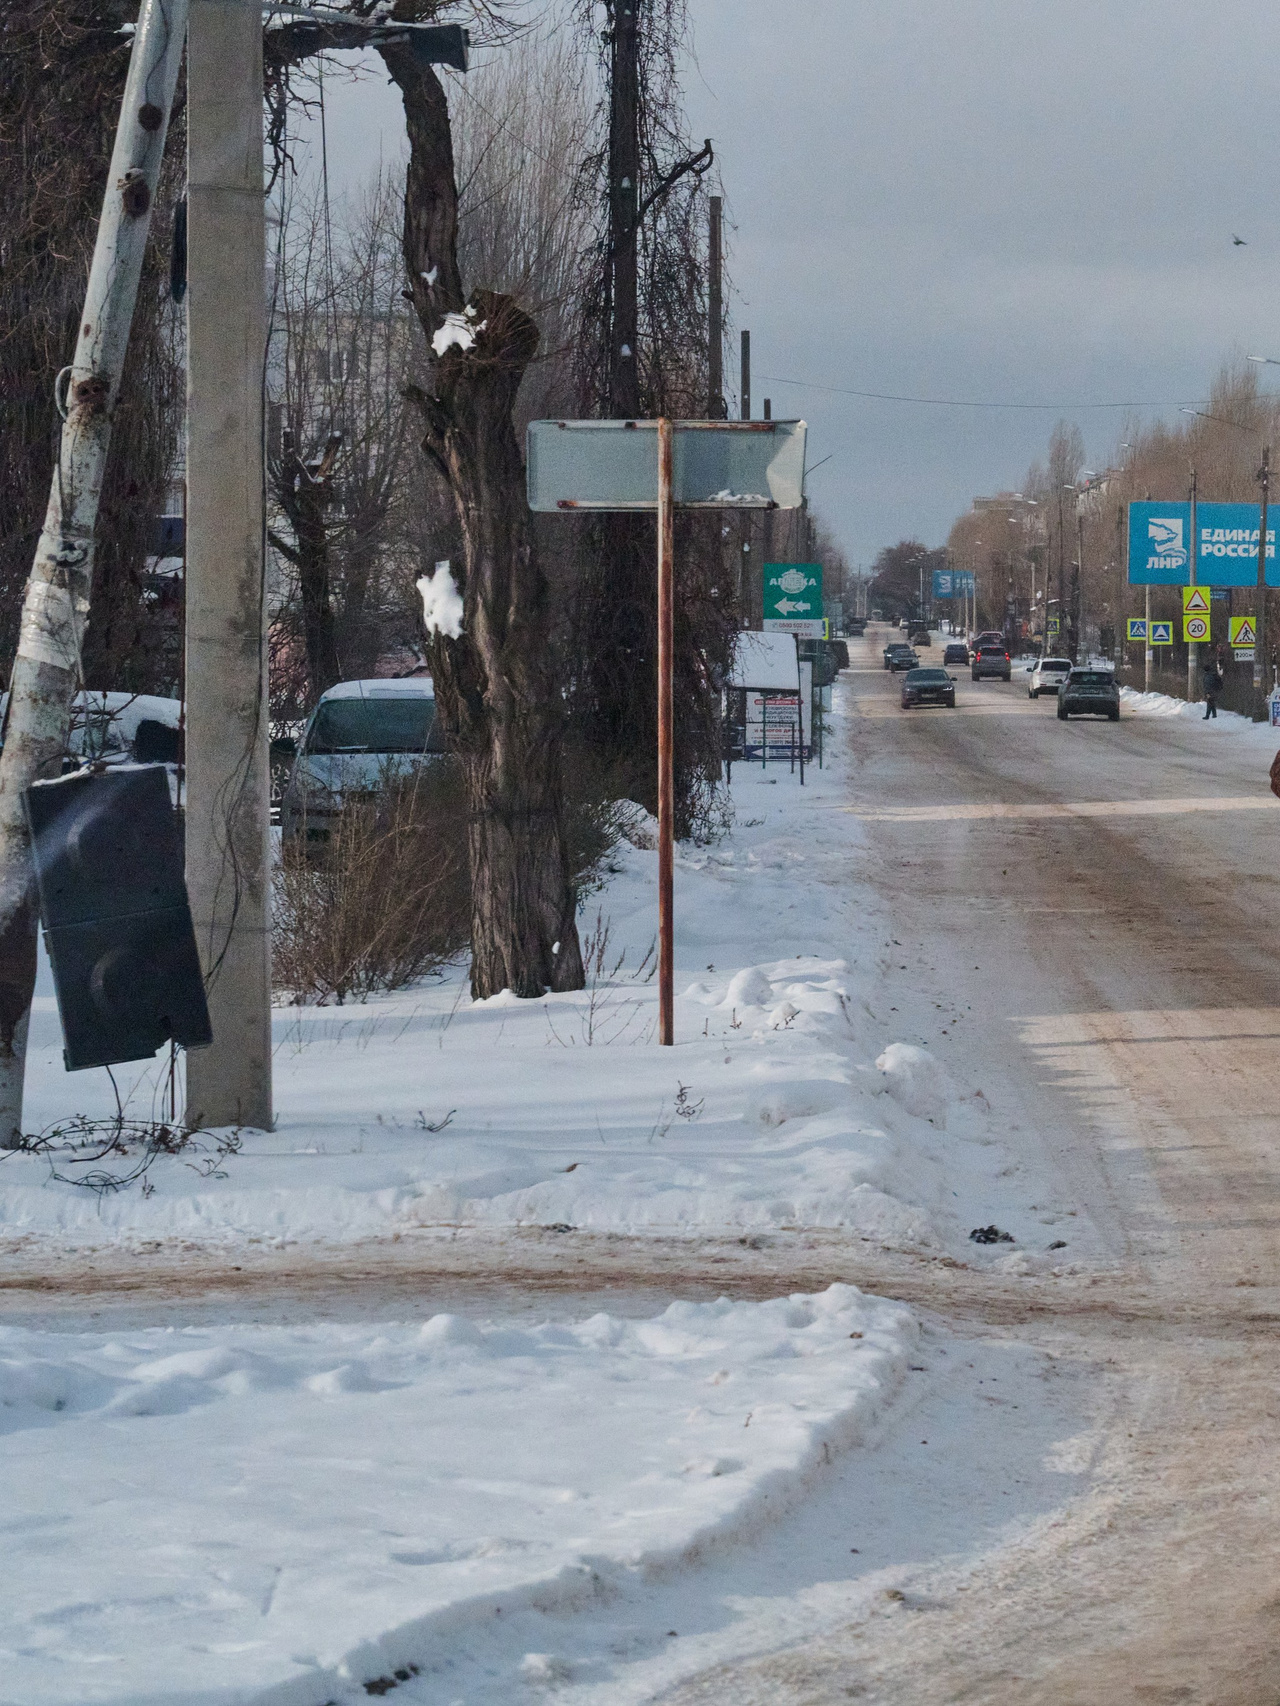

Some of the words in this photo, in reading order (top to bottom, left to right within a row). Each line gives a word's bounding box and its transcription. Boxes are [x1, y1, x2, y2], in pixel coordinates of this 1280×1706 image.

[1201, 528, 1275, 543] ЕДИНАЯ
[1201, 543, 1276, 558] РОССИЯ
[1146, 557, 1183, 569] ЛНР
[769, 577, 817, 586] АПТЕКА
[1191, 624, 1203, 633] 20
